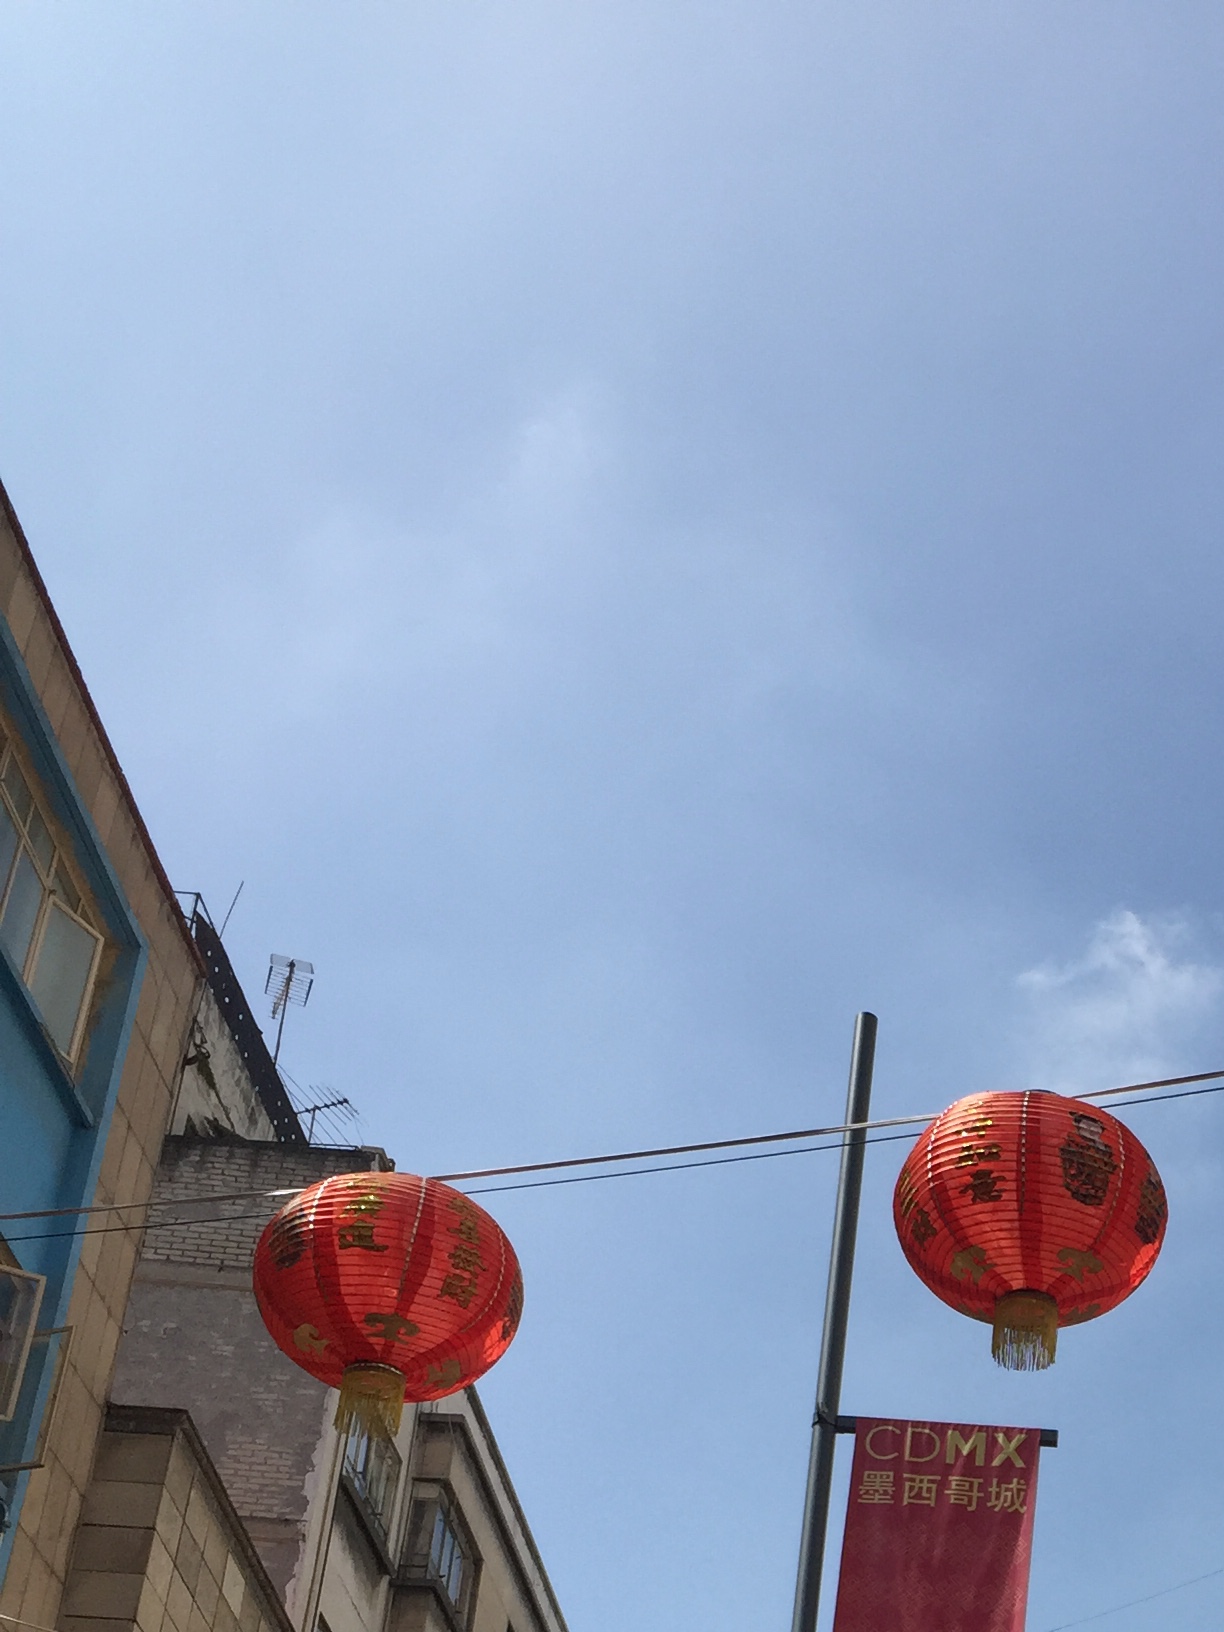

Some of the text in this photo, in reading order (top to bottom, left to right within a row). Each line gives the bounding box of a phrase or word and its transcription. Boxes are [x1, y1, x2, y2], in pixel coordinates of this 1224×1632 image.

[865, 1425, 1028, 1468] CDMX
[857, 1470, 1027, 1514] 墨西哥城
